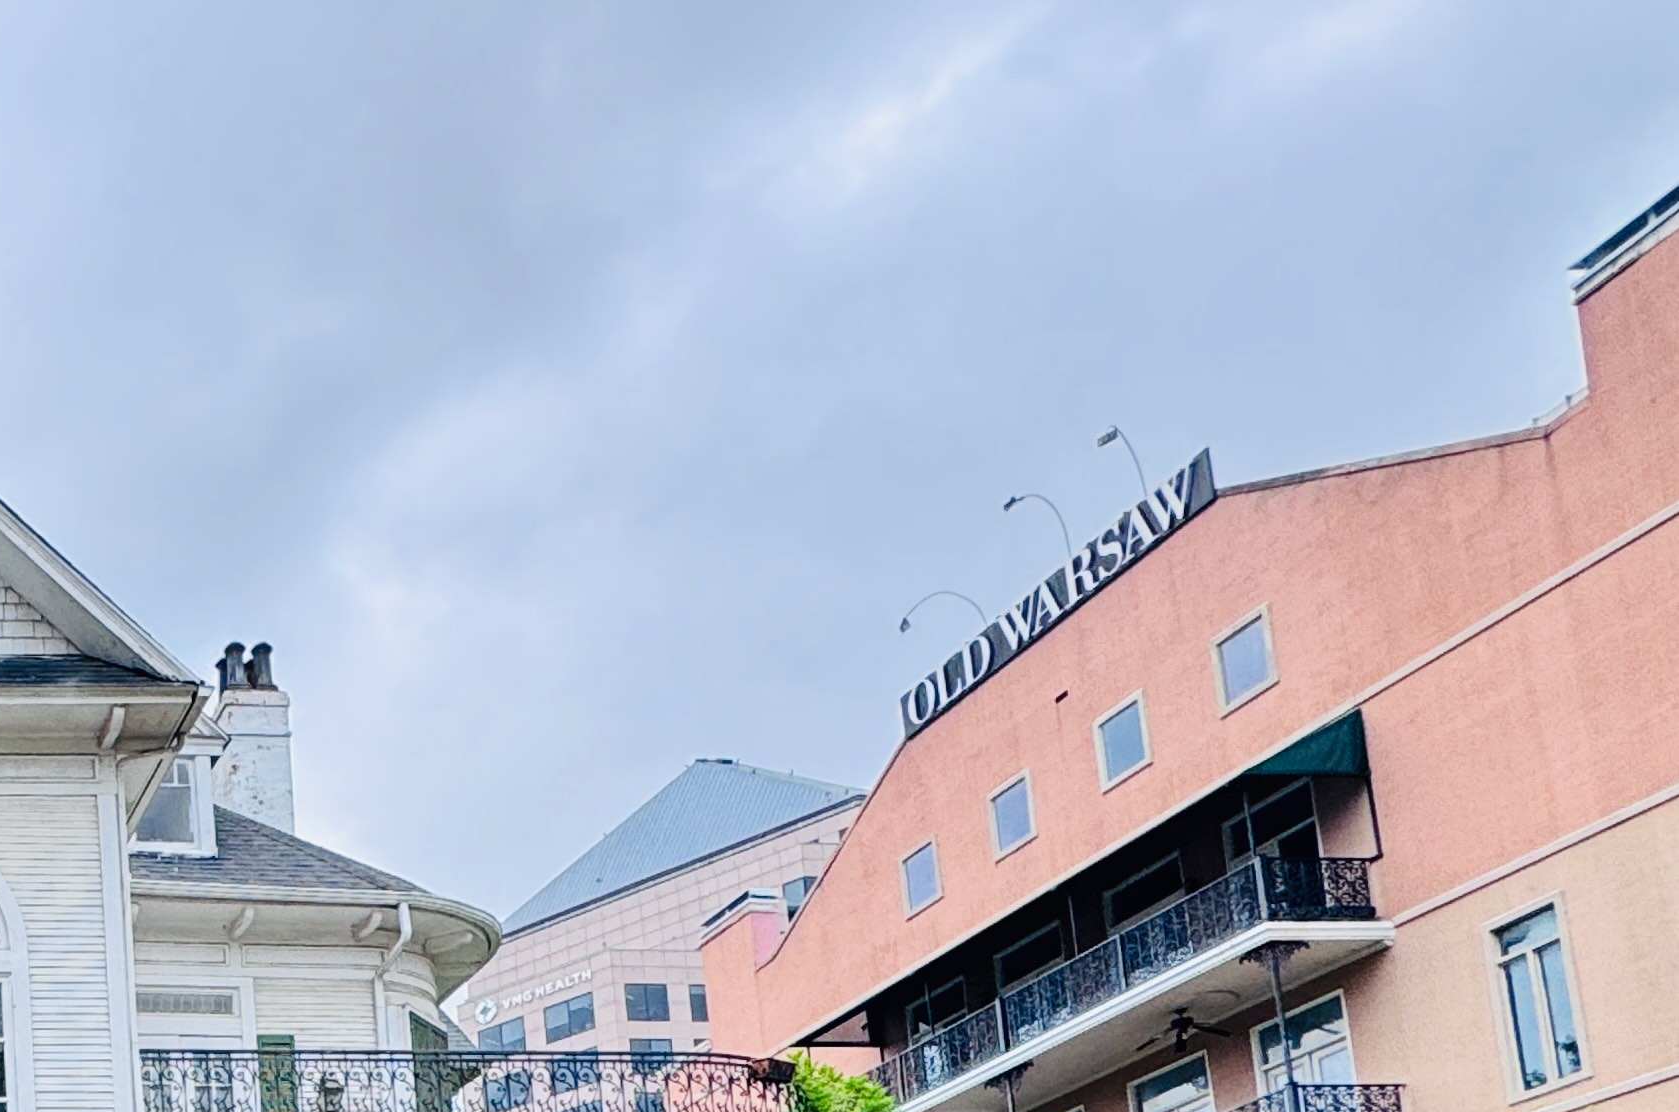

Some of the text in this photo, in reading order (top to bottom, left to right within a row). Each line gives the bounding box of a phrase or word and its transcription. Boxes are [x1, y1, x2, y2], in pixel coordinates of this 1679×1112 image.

[906, 461, 1197, 726] OLD WARSAW
[535, 968, 592, 999] HEALTH
